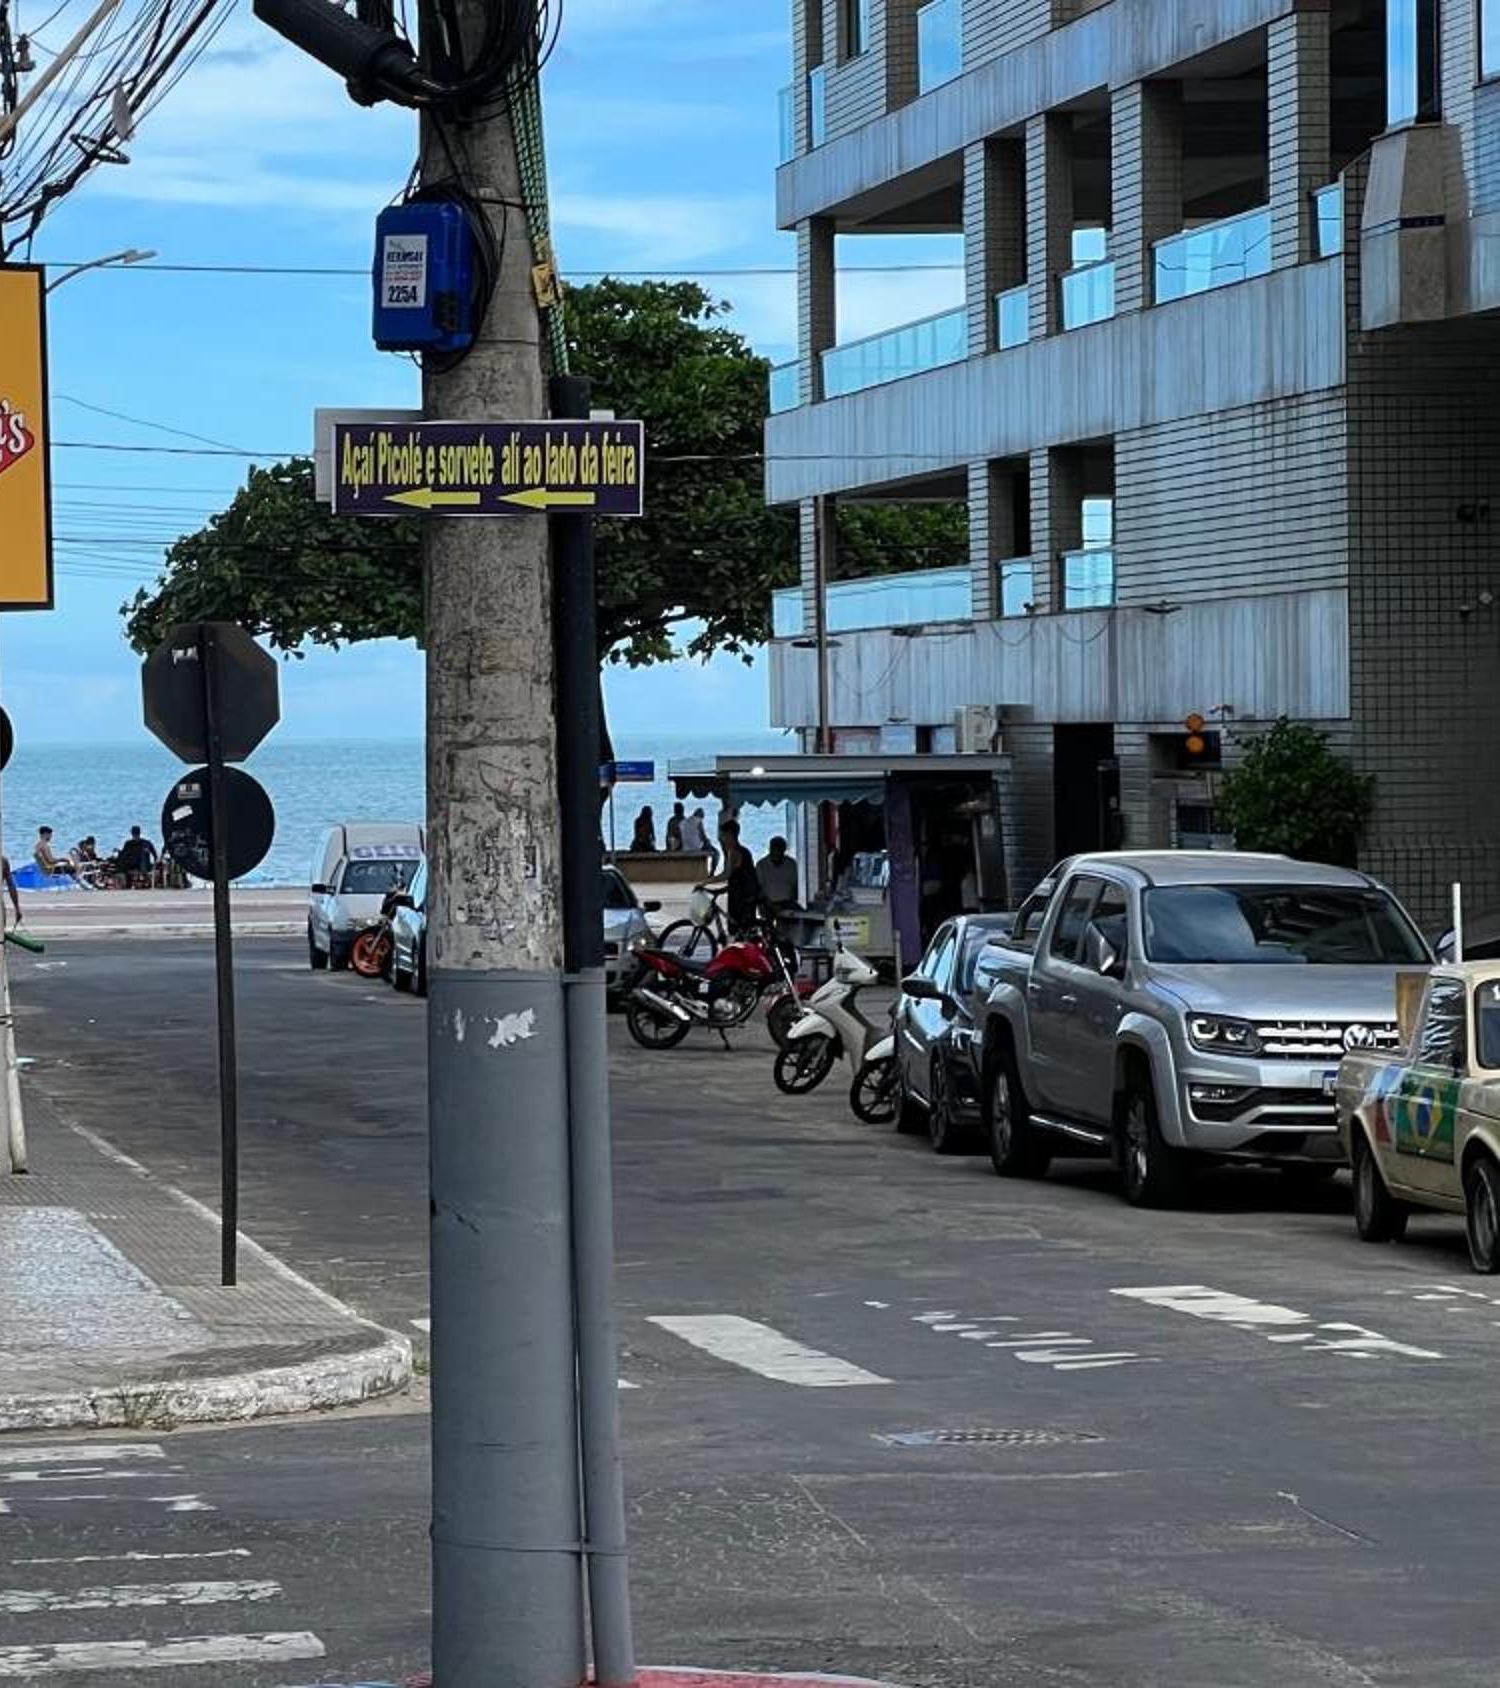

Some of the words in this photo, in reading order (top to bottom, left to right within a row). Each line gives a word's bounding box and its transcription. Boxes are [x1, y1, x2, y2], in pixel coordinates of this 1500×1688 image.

[341, 431, 375, 499] Açaí
[377, 431, 423, 485] Picolé
[425, 445, 436, 485] e
[439, 432, 495, 485] sorvete
[523, 445, 542, 485] ao
[545, 431, 577, 485] lado
[581, 431, 599, 485] da
[601, 431, 636, 485] feira
